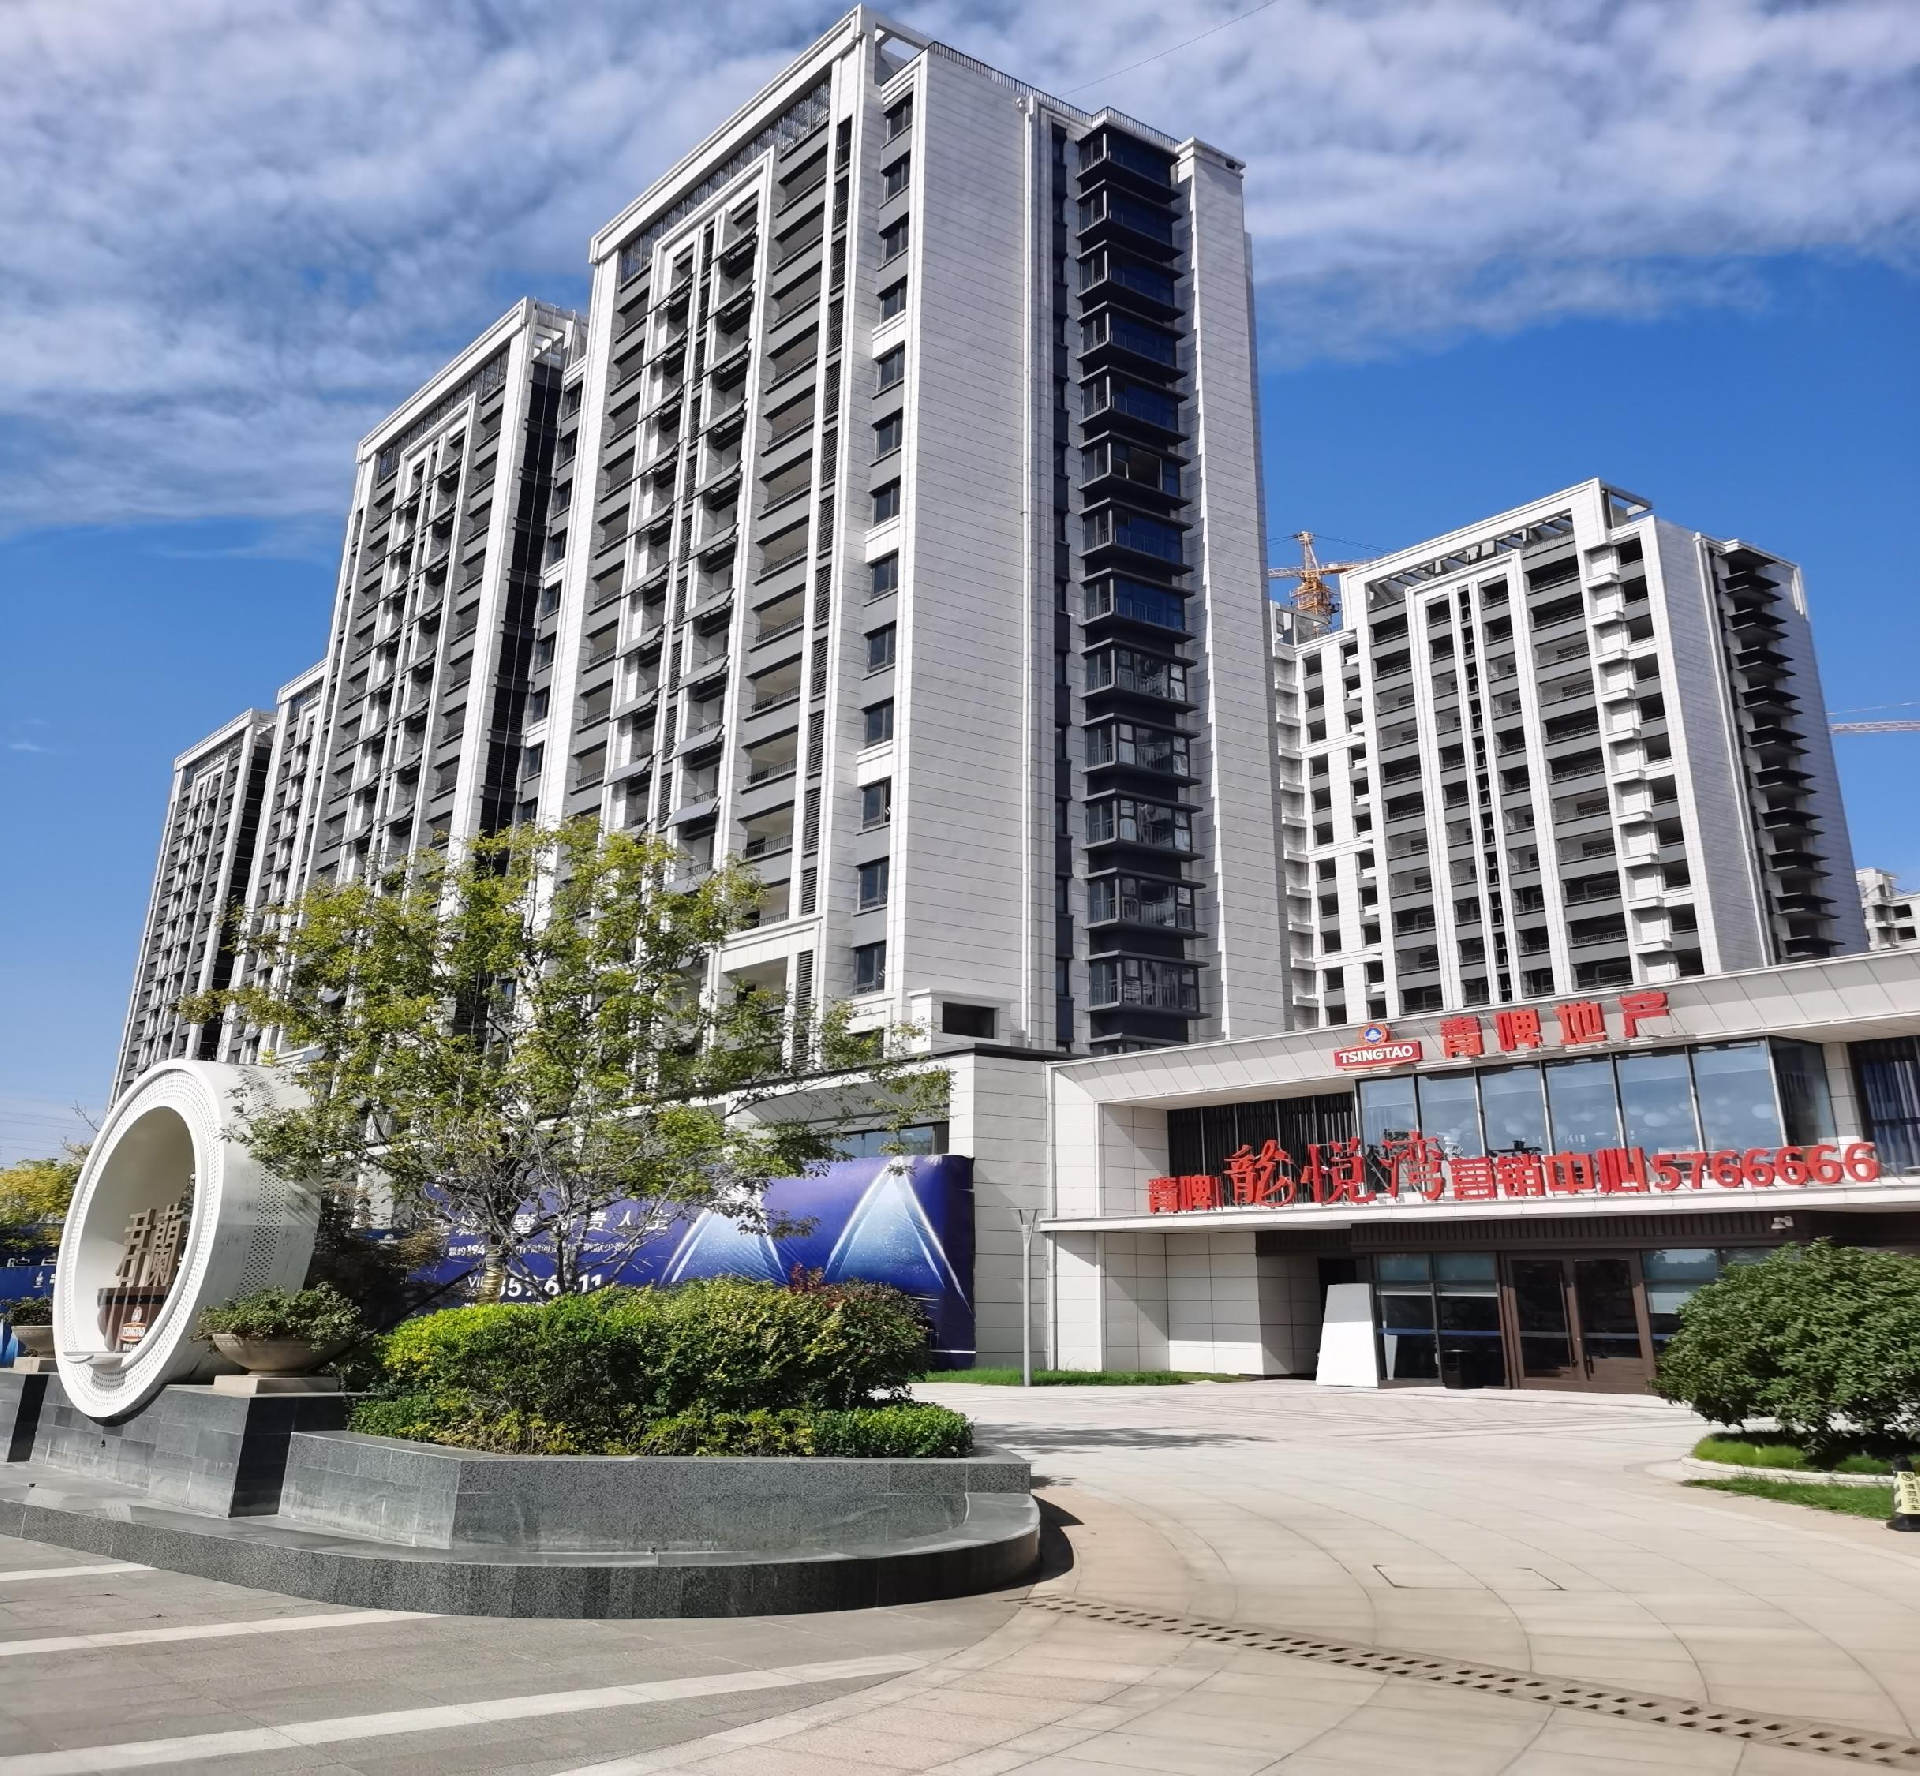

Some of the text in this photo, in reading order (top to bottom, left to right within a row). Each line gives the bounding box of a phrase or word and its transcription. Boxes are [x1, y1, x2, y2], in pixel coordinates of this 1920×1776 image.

[1440, 992, 1669, 1058] 青啤地产
[1342, 1045, 1414, 1063] TSINGTAO
[1149, 1175, 1215, 1213] 青啤
